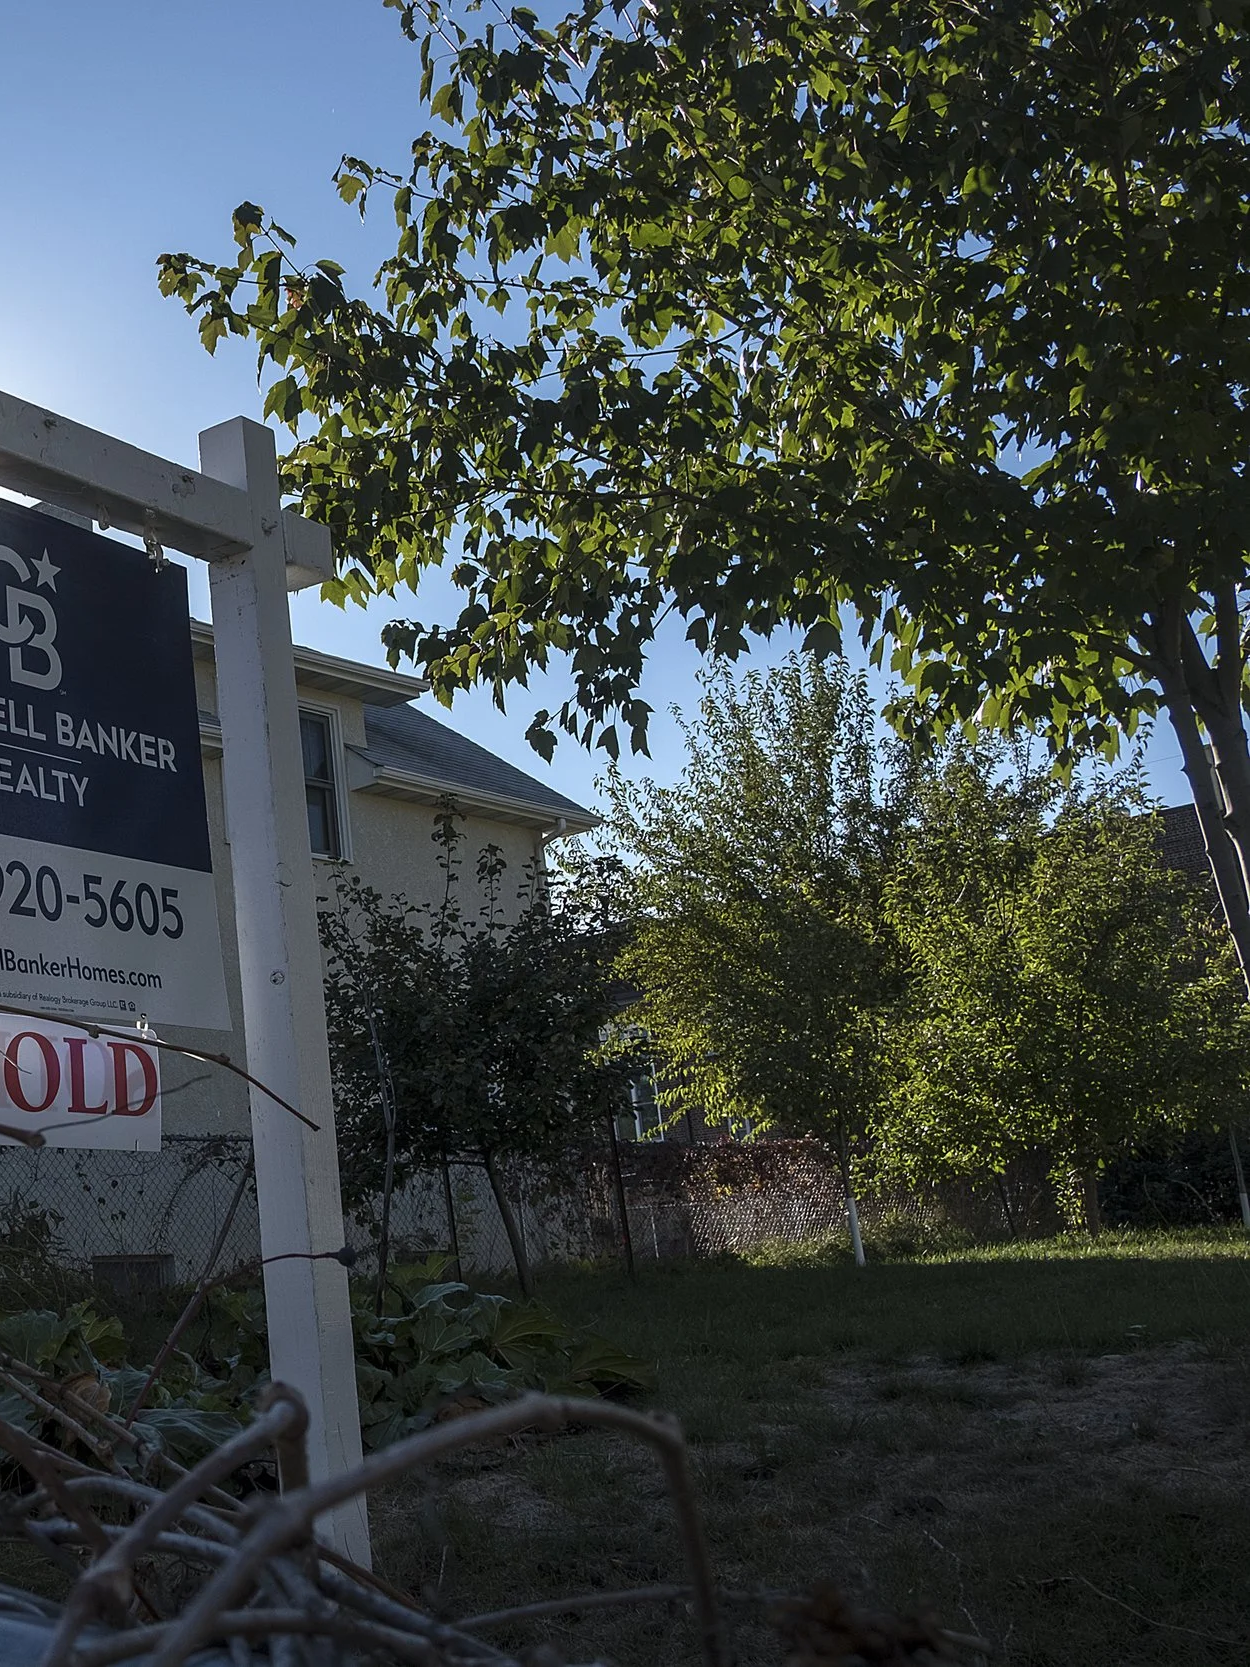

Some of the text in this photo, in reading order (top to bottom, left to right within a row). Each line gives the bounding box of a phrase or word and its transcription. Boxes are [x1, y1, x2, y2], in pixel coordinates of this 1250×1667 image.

[55, 711, 178, 773] BANKER
[2, 991, 31, 1002] subsidiary
[32, 992, 38, 1001] of
[61, 995, 89, 1007] Brokerage
[89, 998, 107, 1009] Group
